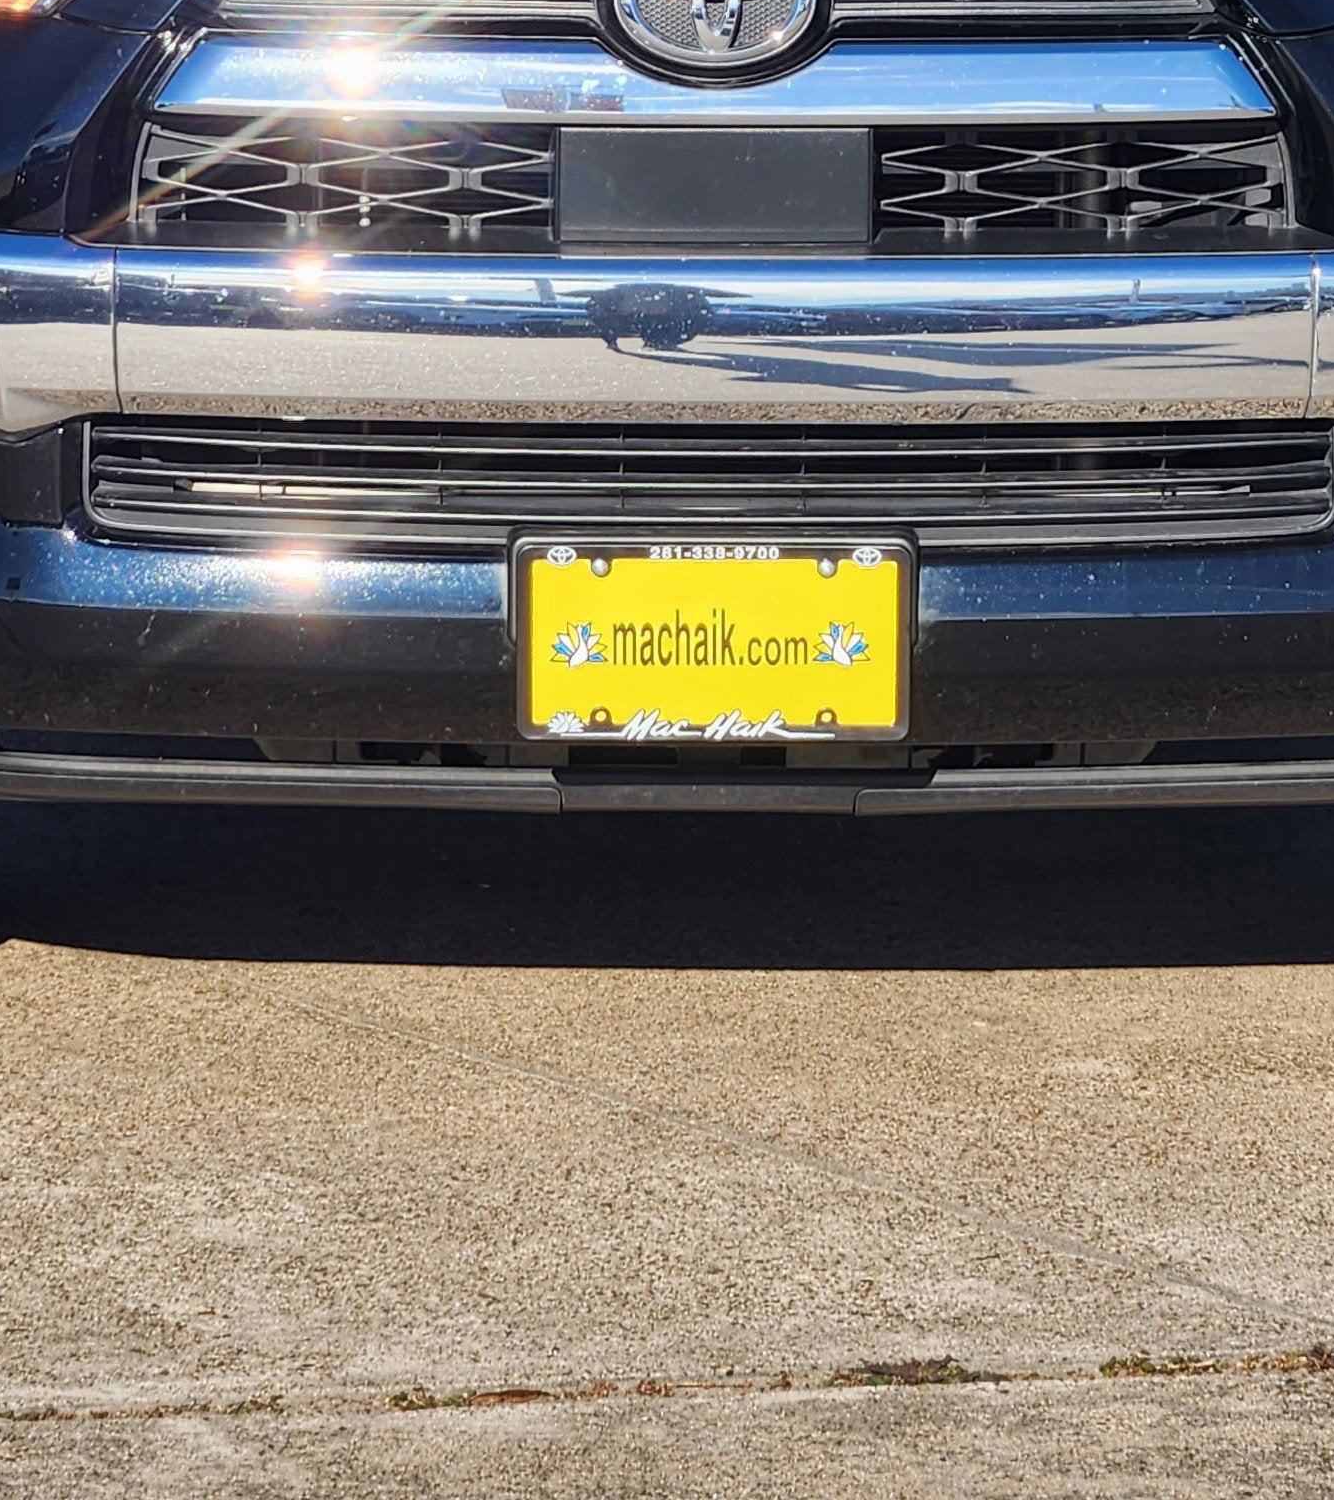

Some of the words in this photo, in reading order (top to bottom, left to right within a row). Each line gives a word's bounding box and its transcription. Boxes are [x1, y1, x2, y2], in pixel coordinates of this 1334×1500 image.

[612, 608, 809, 667] machaik.com
[620, 708, 701, 741] Mac
[701, 708, 793, 741] Haik
